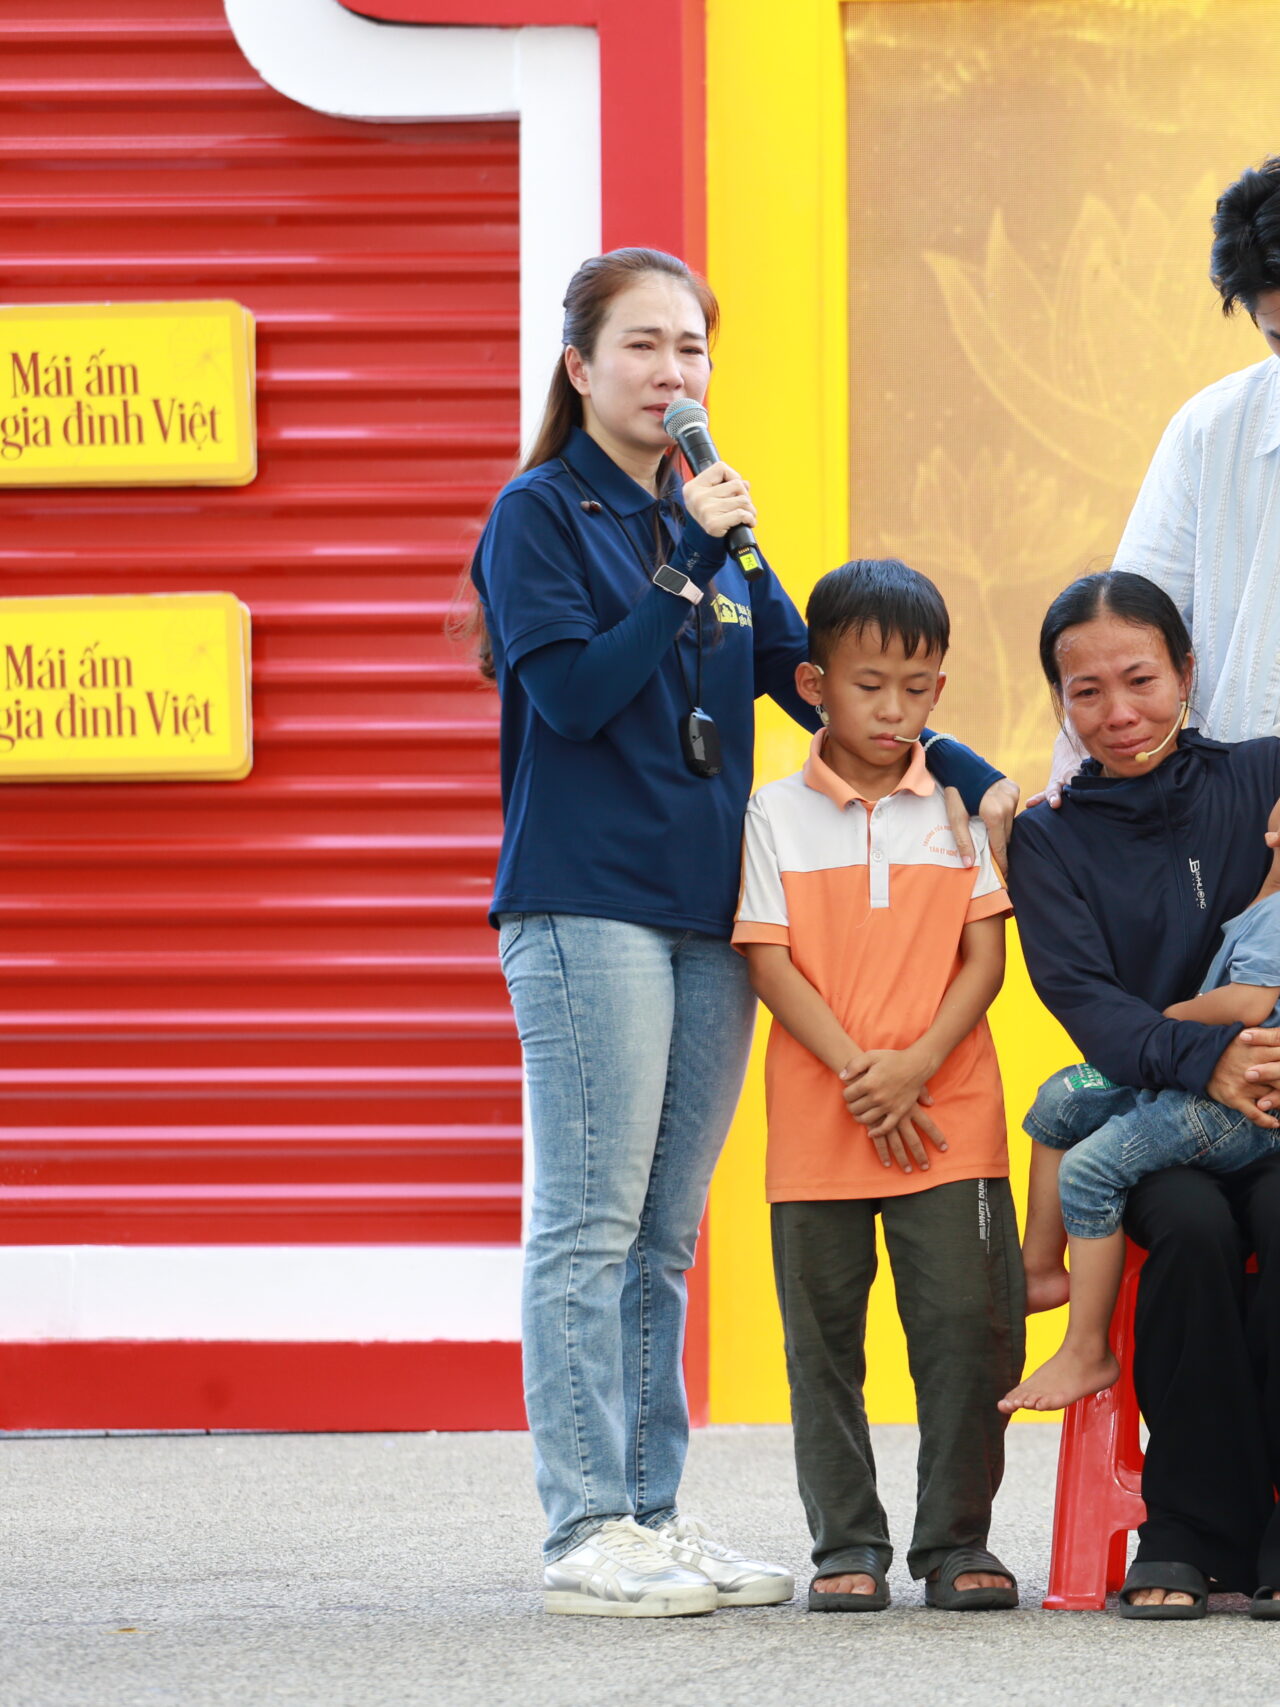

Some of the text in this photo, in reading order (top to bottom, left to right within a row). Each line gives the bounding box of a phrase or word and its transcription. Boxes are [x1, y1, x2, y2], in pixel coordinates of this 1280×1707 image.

[10, 348, 140, 398] Mái ấm
[0, 398, 222, 461] gia đình Việt
[5, 641, 133, 691] Mái ấm
[0, 691, 214, 752] gia đình Việt
